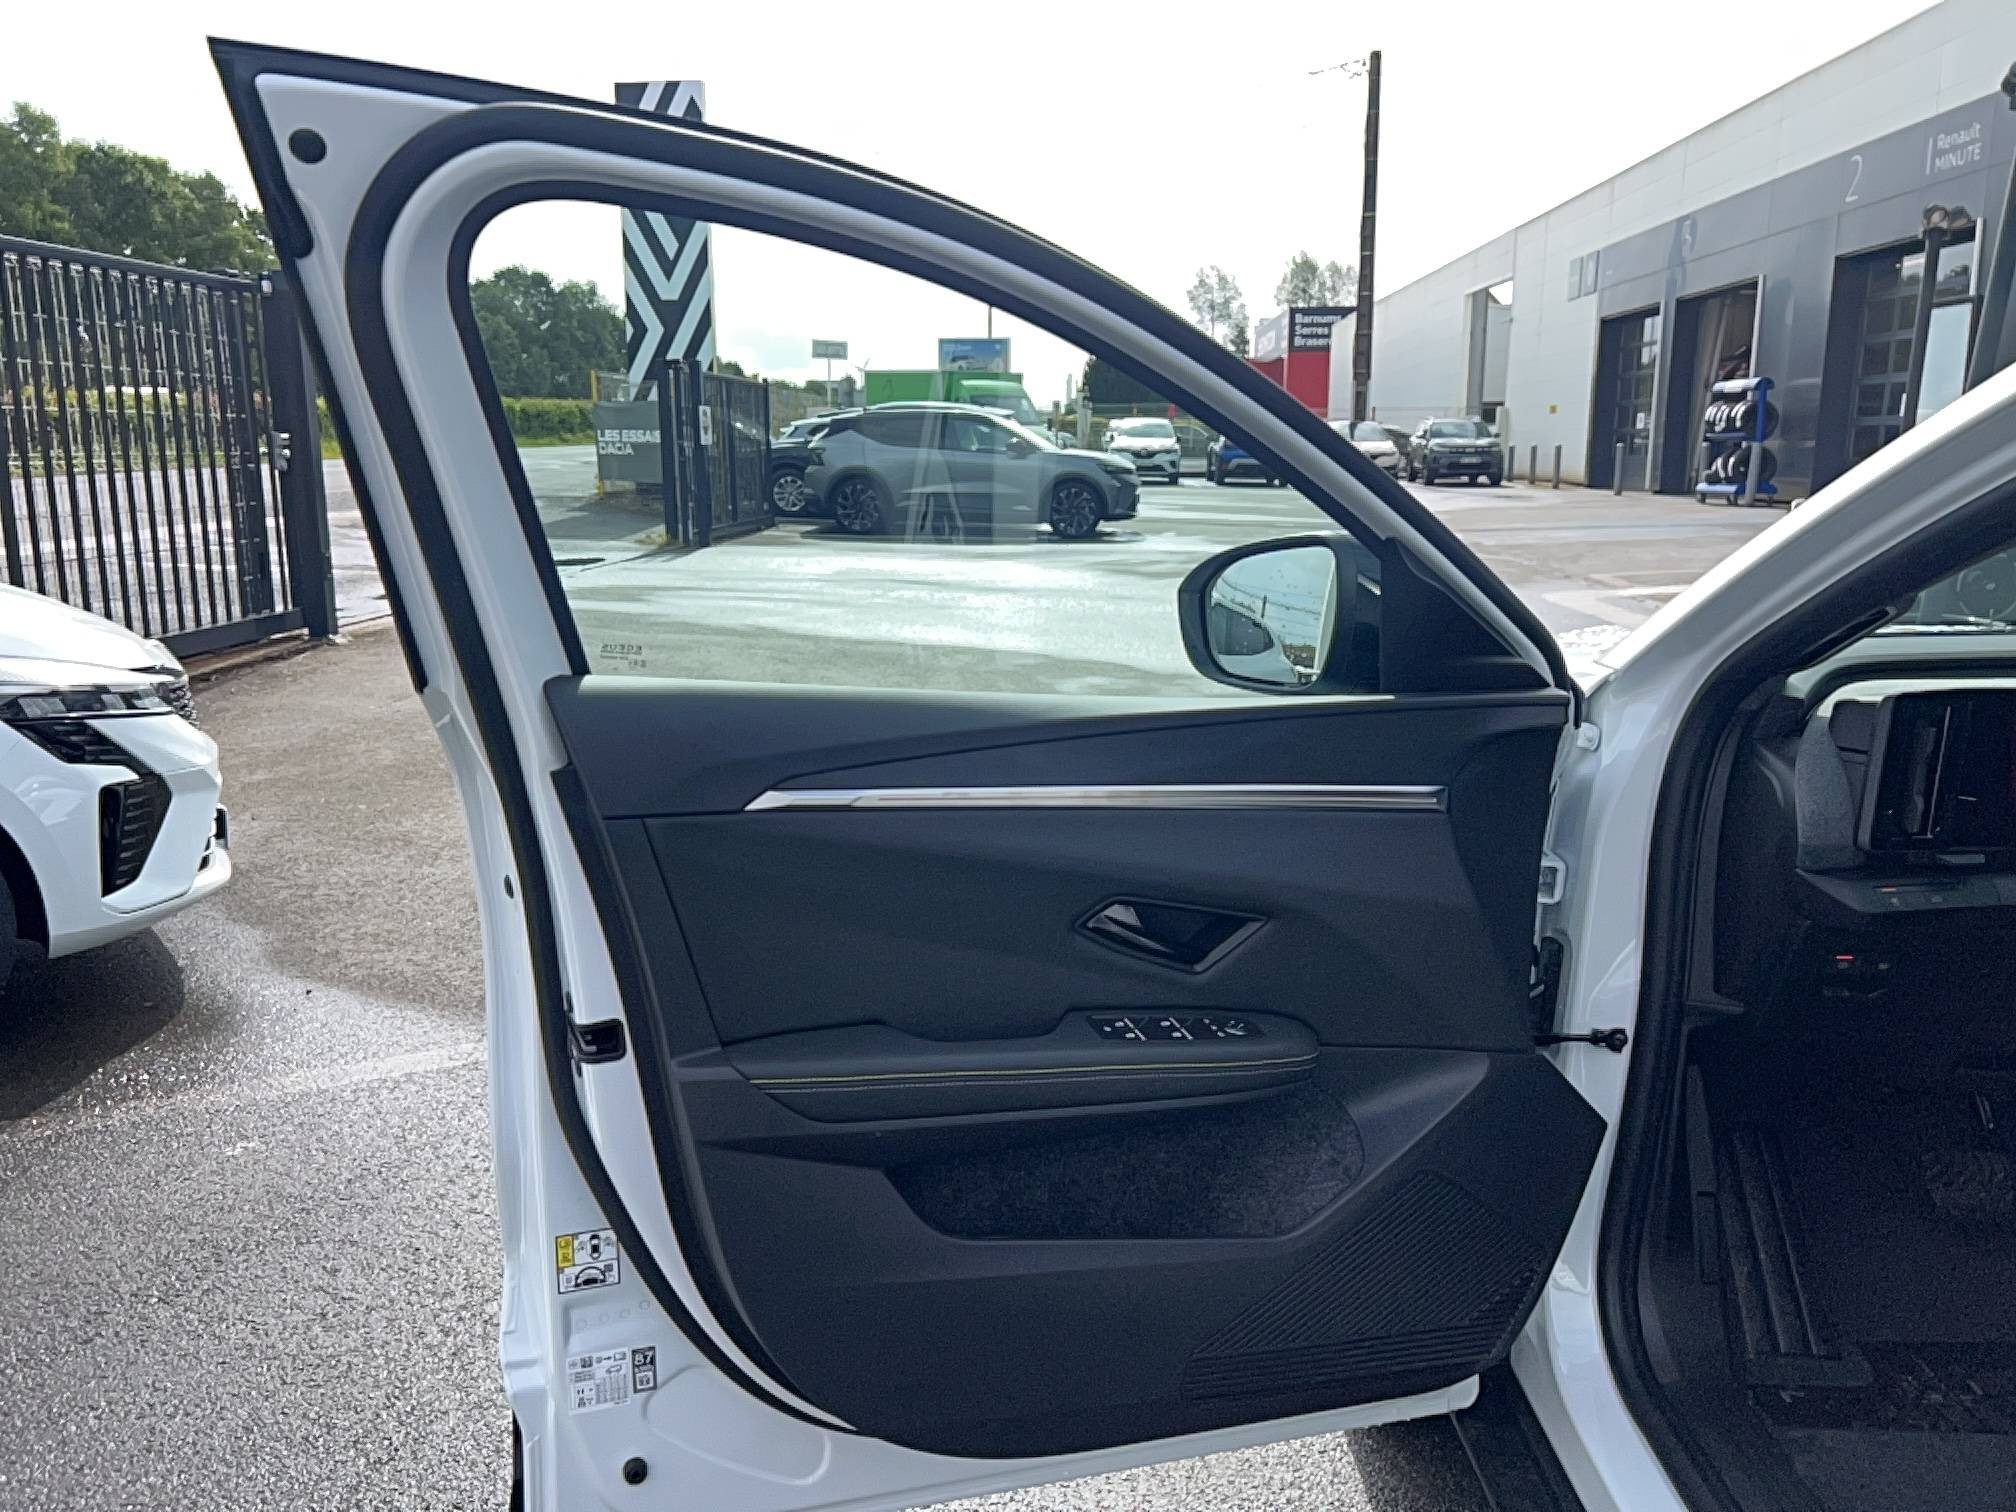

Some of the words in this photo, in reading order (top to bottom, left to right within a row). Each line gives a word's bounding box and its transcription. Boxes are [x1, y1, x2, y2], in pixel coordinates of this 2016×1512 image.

[1934, 142, 1983, 173] MINUTE
[1845, 154, 1863, 203] 2
[597, 429, 620, 441] LES
